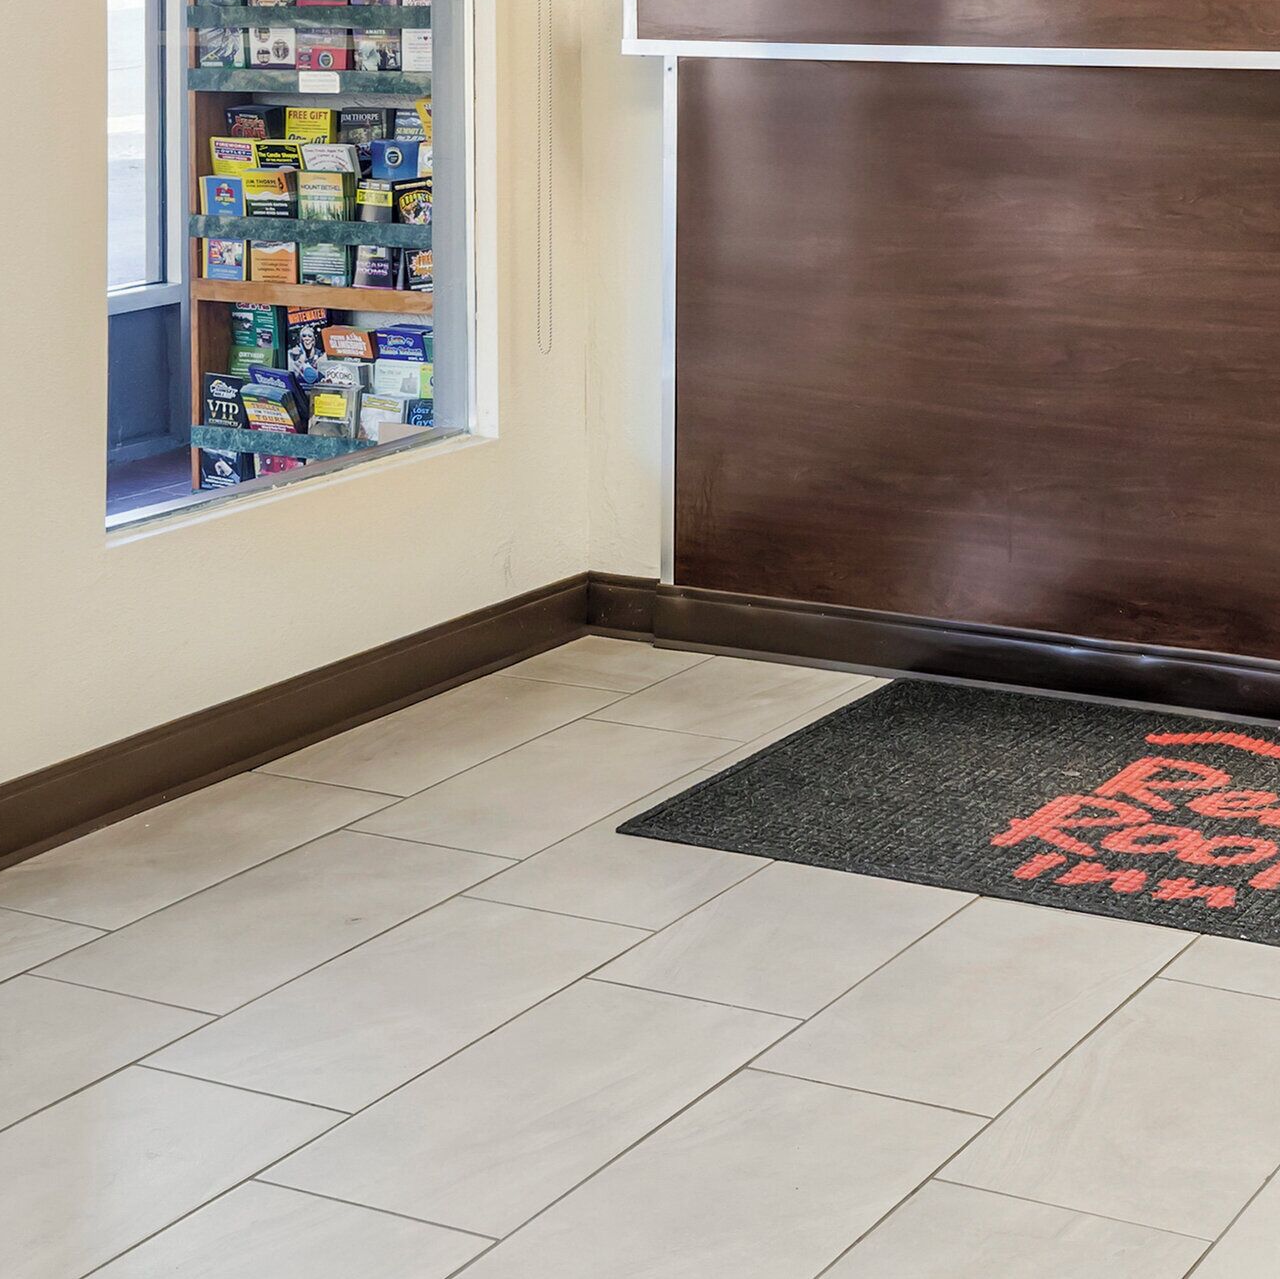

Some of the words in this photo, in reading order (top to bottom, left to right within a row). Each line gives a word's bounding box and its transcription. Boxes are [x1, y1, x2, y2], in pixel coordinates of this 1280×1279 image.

[288, 110, 307, 119] FREE
[310, 111, 328, 120] GIFT
[341, 113, 352, 122] JIM
[352, 113, 380, 121] THORPE
[215, 141, 251, 150] FIREWORKS
[320, 184, 340, 192] BETHEL
[207, 400, 240, 420] VIP
[256, 415, 287, 423] TOURS
